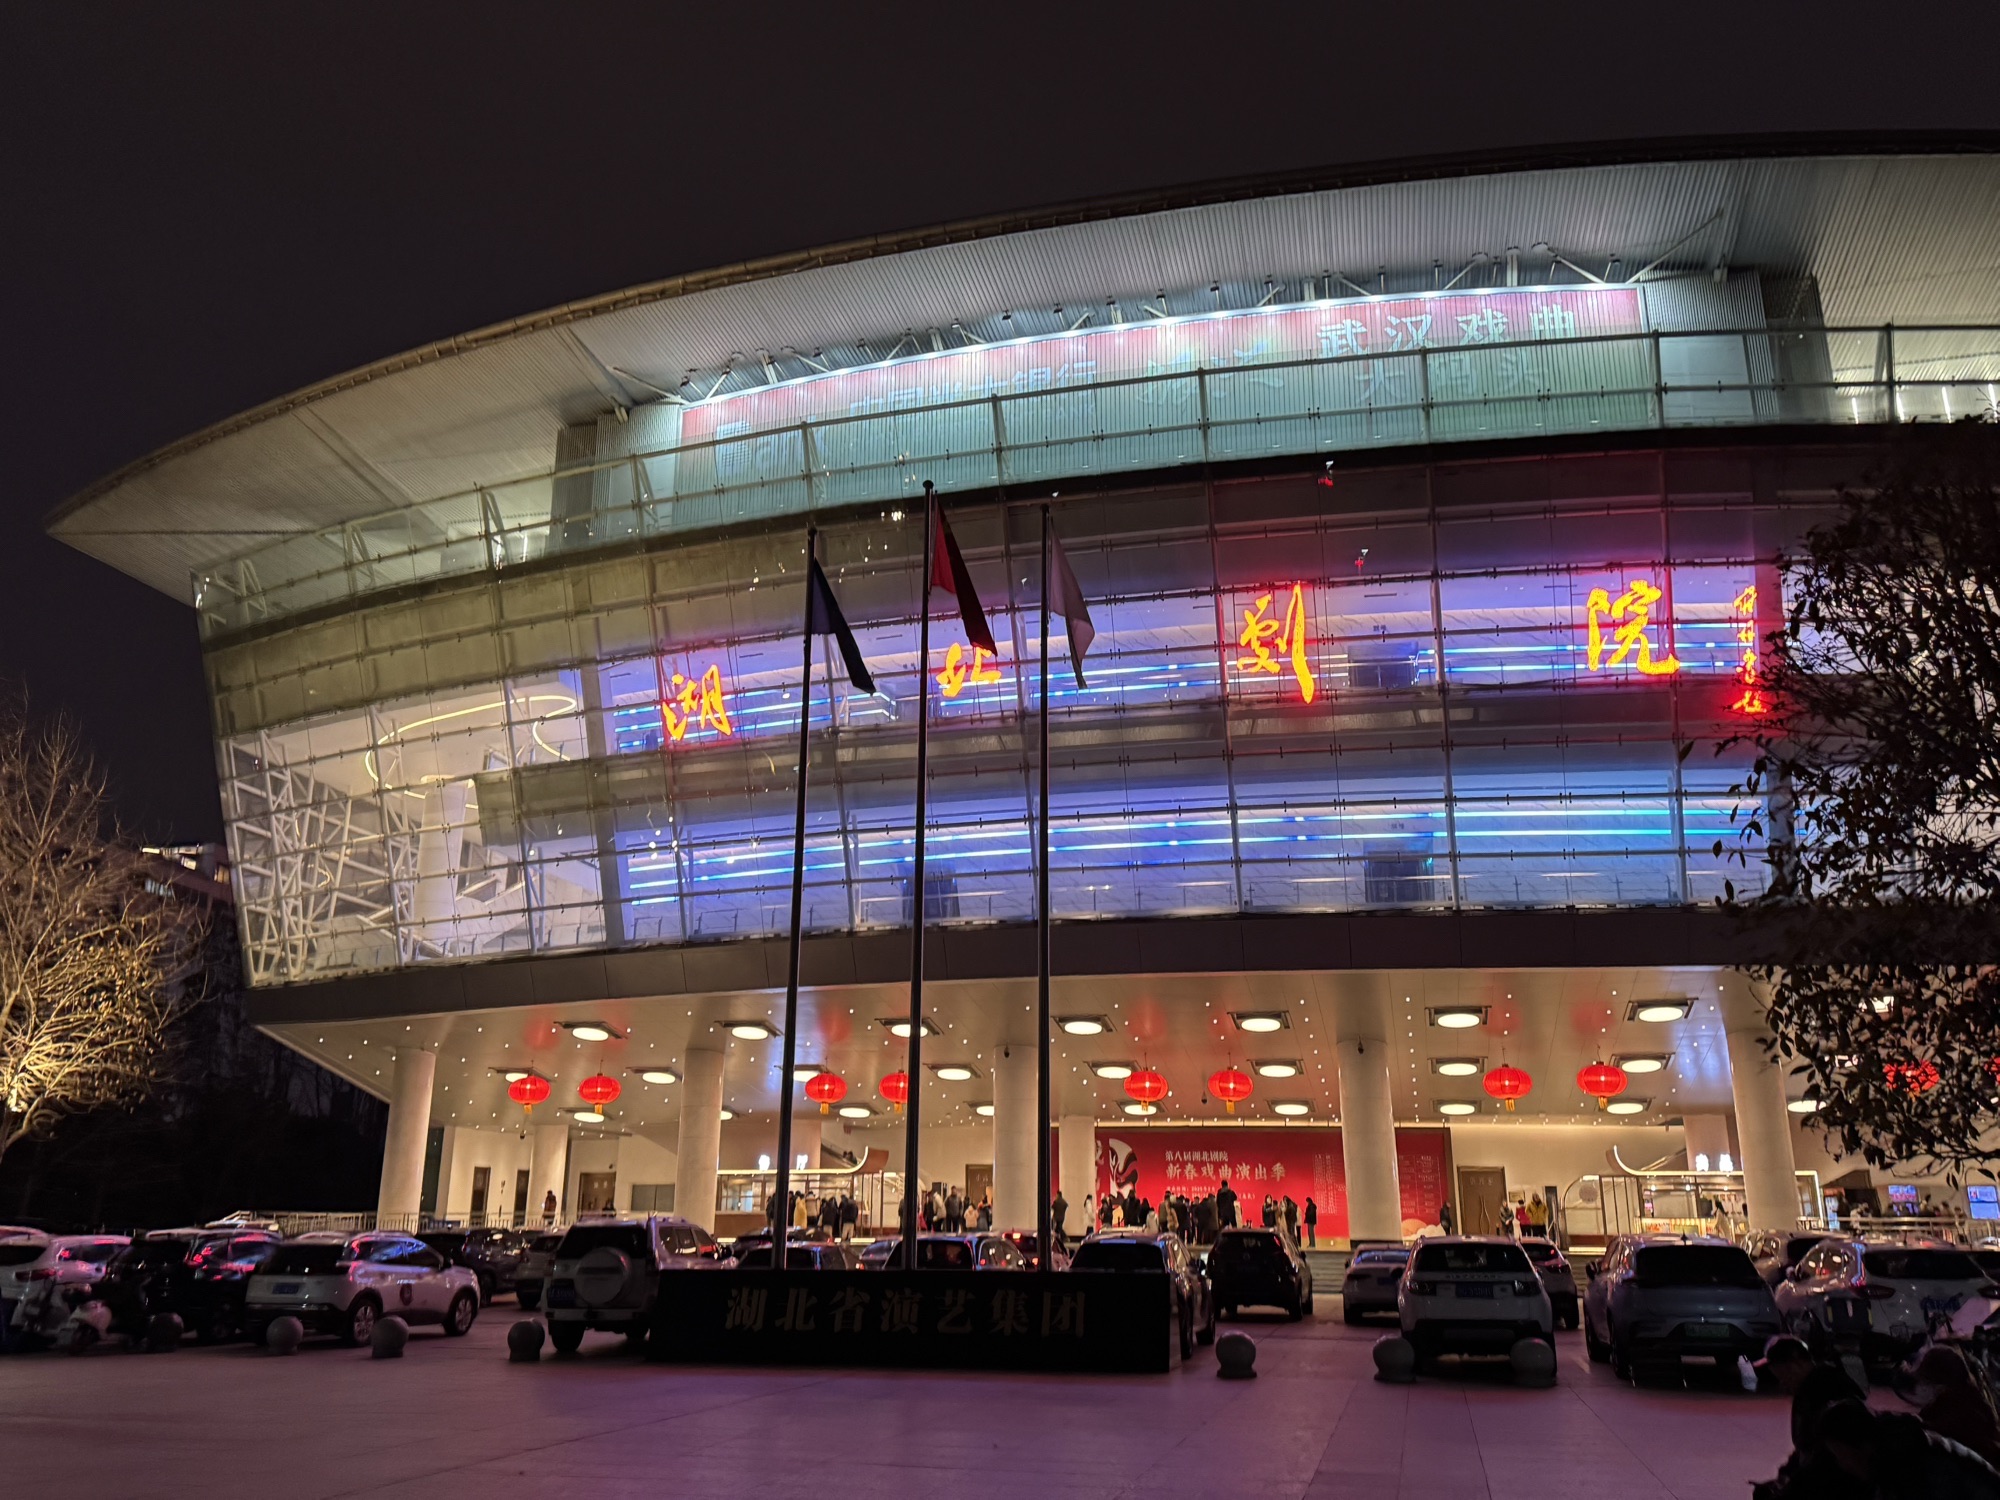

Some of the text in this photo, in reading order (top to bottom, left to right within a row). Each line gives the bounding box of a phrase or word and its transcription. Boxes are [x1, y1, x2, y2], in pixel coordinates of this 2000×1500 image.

[1316, 304, 1575, 360] 武汉戏曲
[1166, 1162, 1286, 1182] 新春戏曲演出季
[725, 1285, 1087, 1338] 湖北省演艺集团
